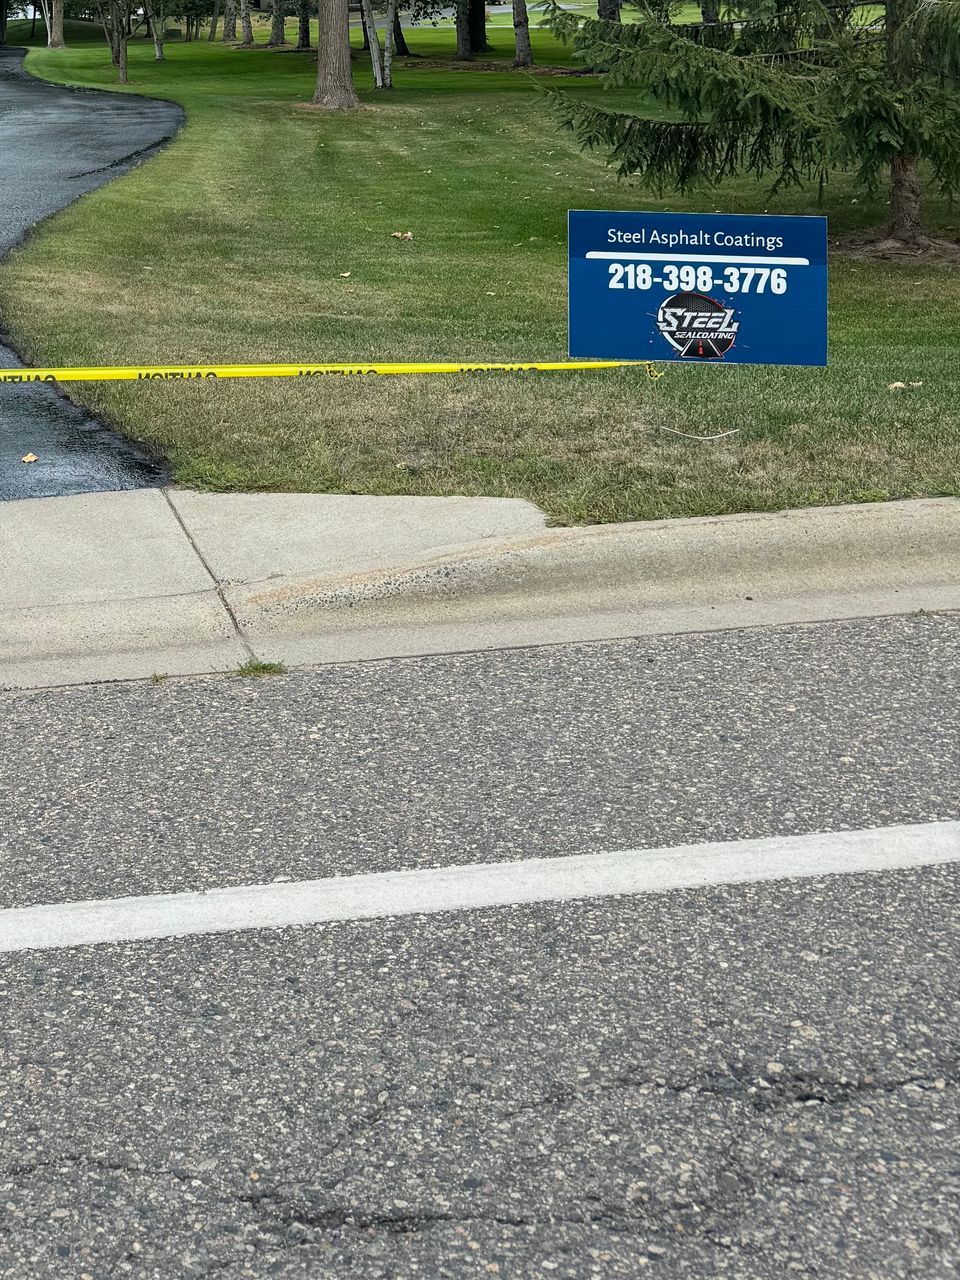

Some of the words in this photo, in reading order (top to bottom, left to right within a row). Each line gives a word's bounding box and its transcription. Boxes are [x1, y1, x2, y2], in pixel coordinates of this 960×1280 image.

[607, 228, 645, 244] Steel
[649, 229, 711, 247] Asphalt
[713, 231, 784, 251] Coatings
[608, 263, 787, 294] 218-398-3776
[656, 307, 740, 332] STEEL
[674, 331, 735, 339] SEALCOATING
